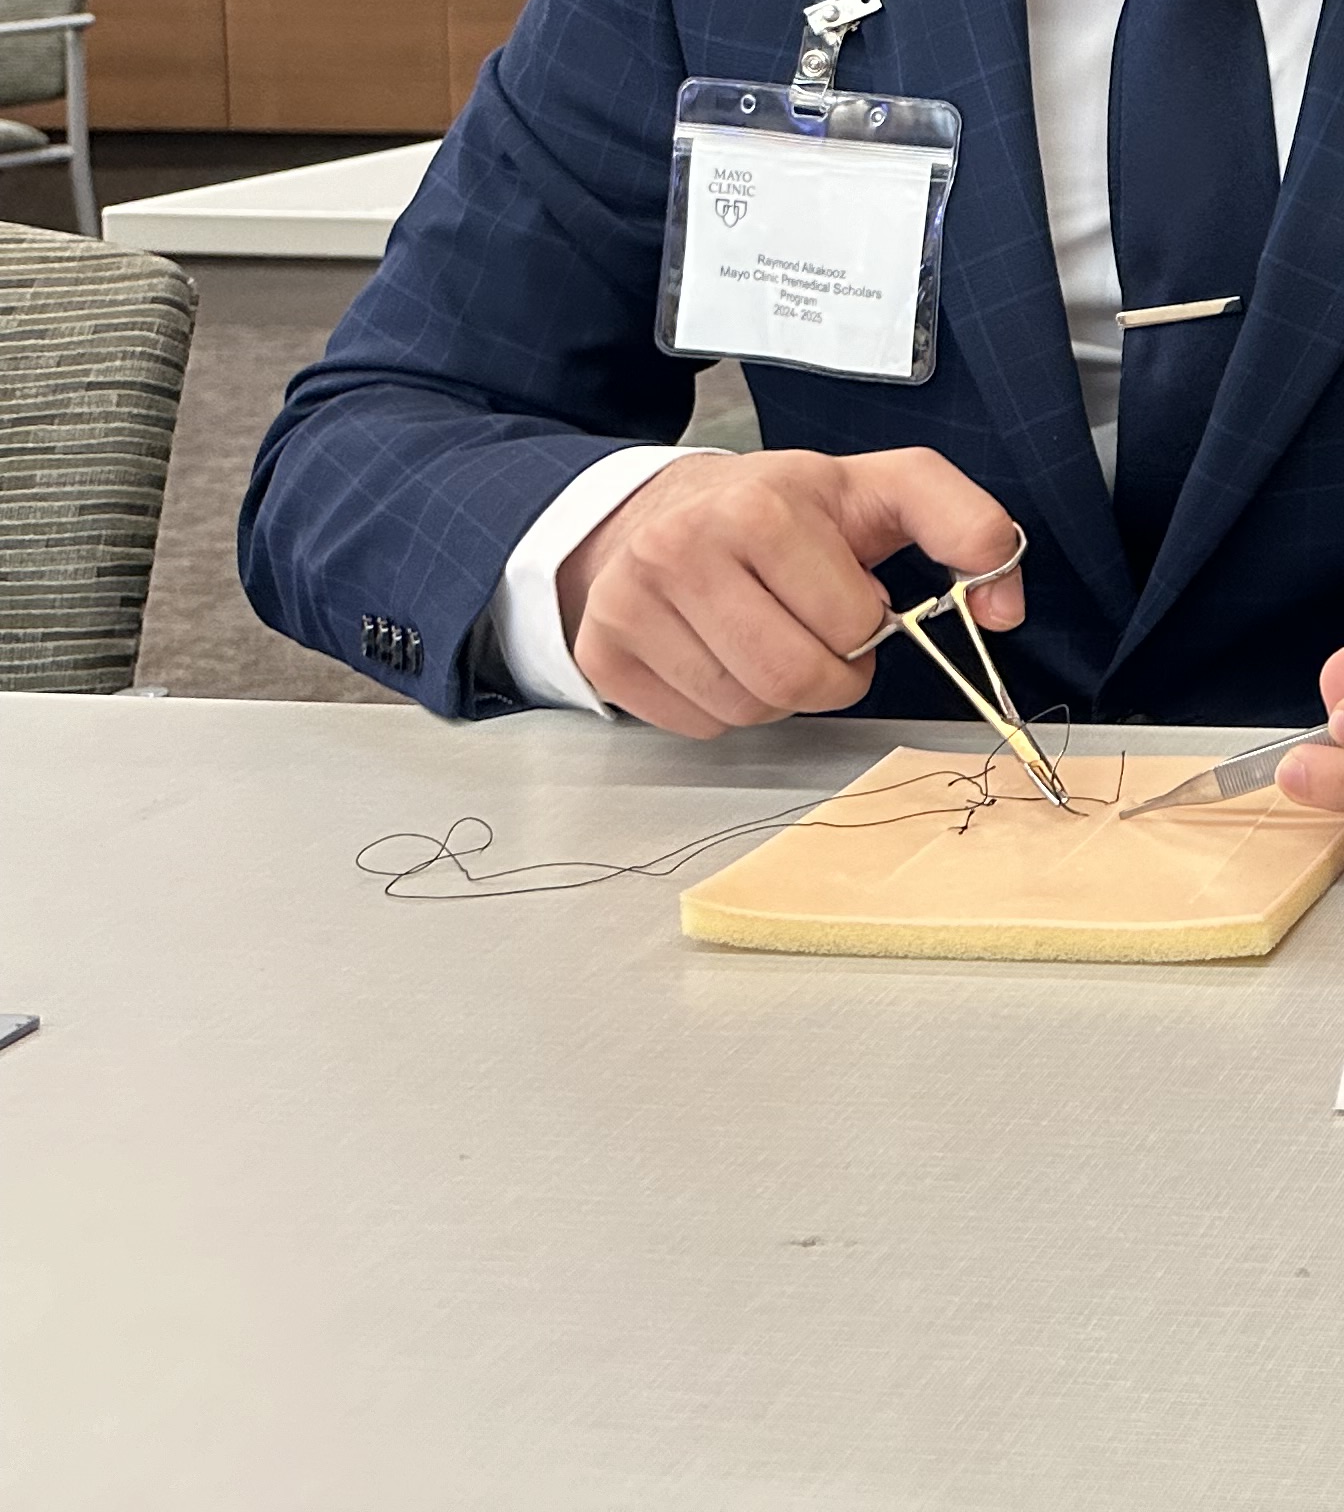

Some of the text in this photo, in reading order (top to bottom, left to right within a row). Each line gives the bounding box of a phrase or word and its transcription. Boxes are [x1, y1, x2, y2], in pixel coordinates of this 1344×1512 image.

[713, 168, 753, 184] MAYO
[708, 181, 756, 197] CLINIC
[757, 253, 800, 273] Raymond
[719, 265, 882, 300] Mayo Clinic Premedical Scholars
[780, 288, 818, 307] Program
